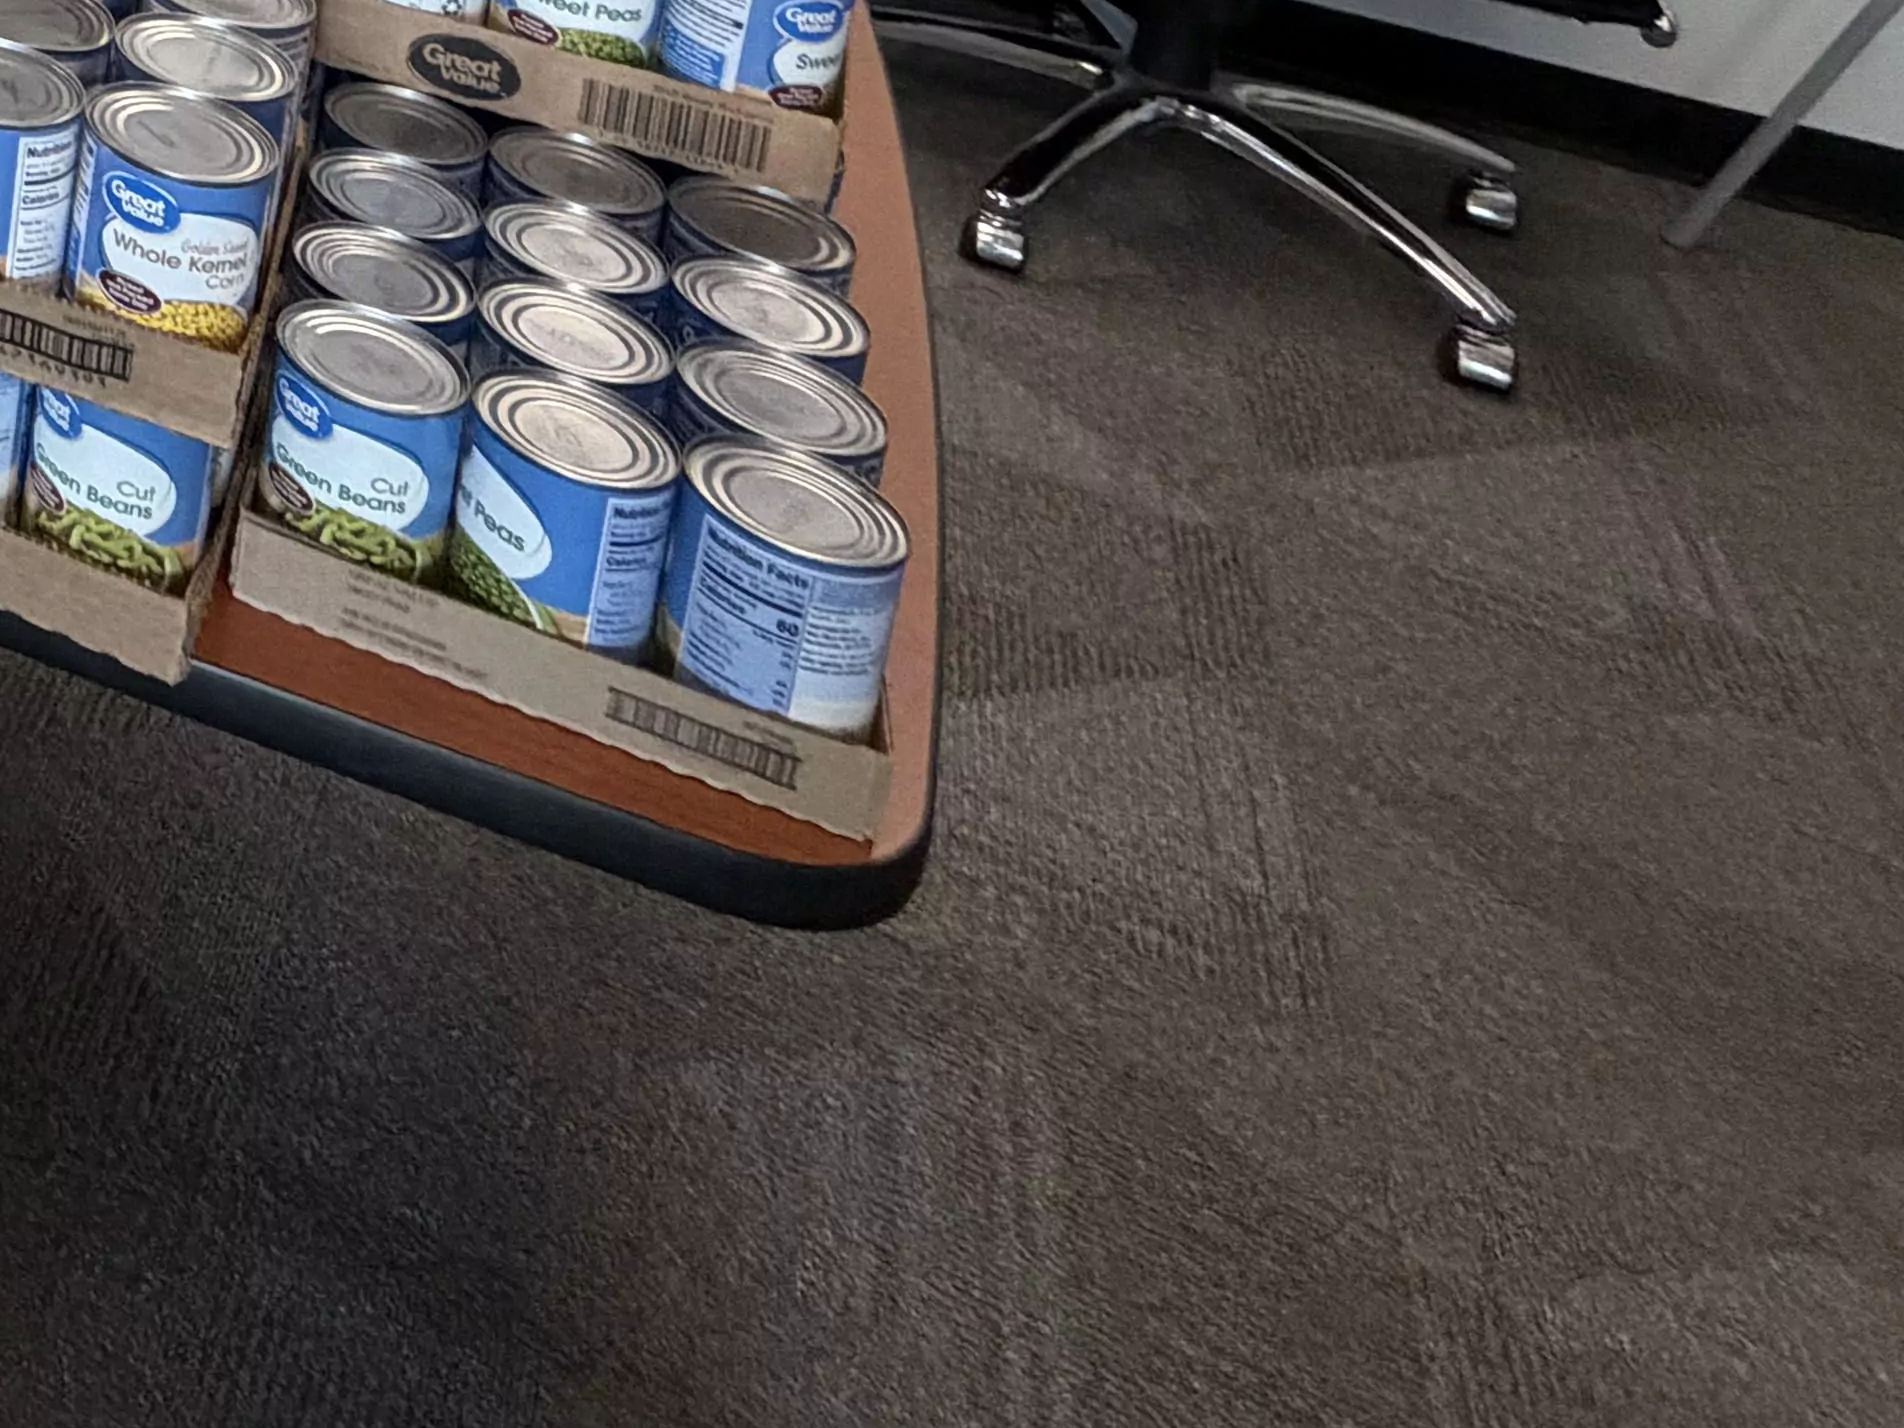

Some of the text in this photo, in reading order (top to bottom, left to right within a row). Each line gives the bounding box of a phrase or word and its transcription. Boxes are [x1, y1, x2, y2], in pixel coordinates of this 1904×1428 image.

[595, 5, 643, 23] Peas
[785, 7, 837, 27] Great
[422, 43, 502, 84] Great
[442, 64, 501, 95] Value
[111, 179, 166, 216] Great
[113, 228, 248, 275] Whole Kernel
[205, 271, 245, 290] Corn
[37, 442, 153, 520] Green Beans
[116, 480, 157, 502] Cut
[276, 443, 407, 515] Green Beans
[370, 476, 410, 497] Cut
[474, 501, 526, 553] Peas
[767, 560, 810, 589] Facts
